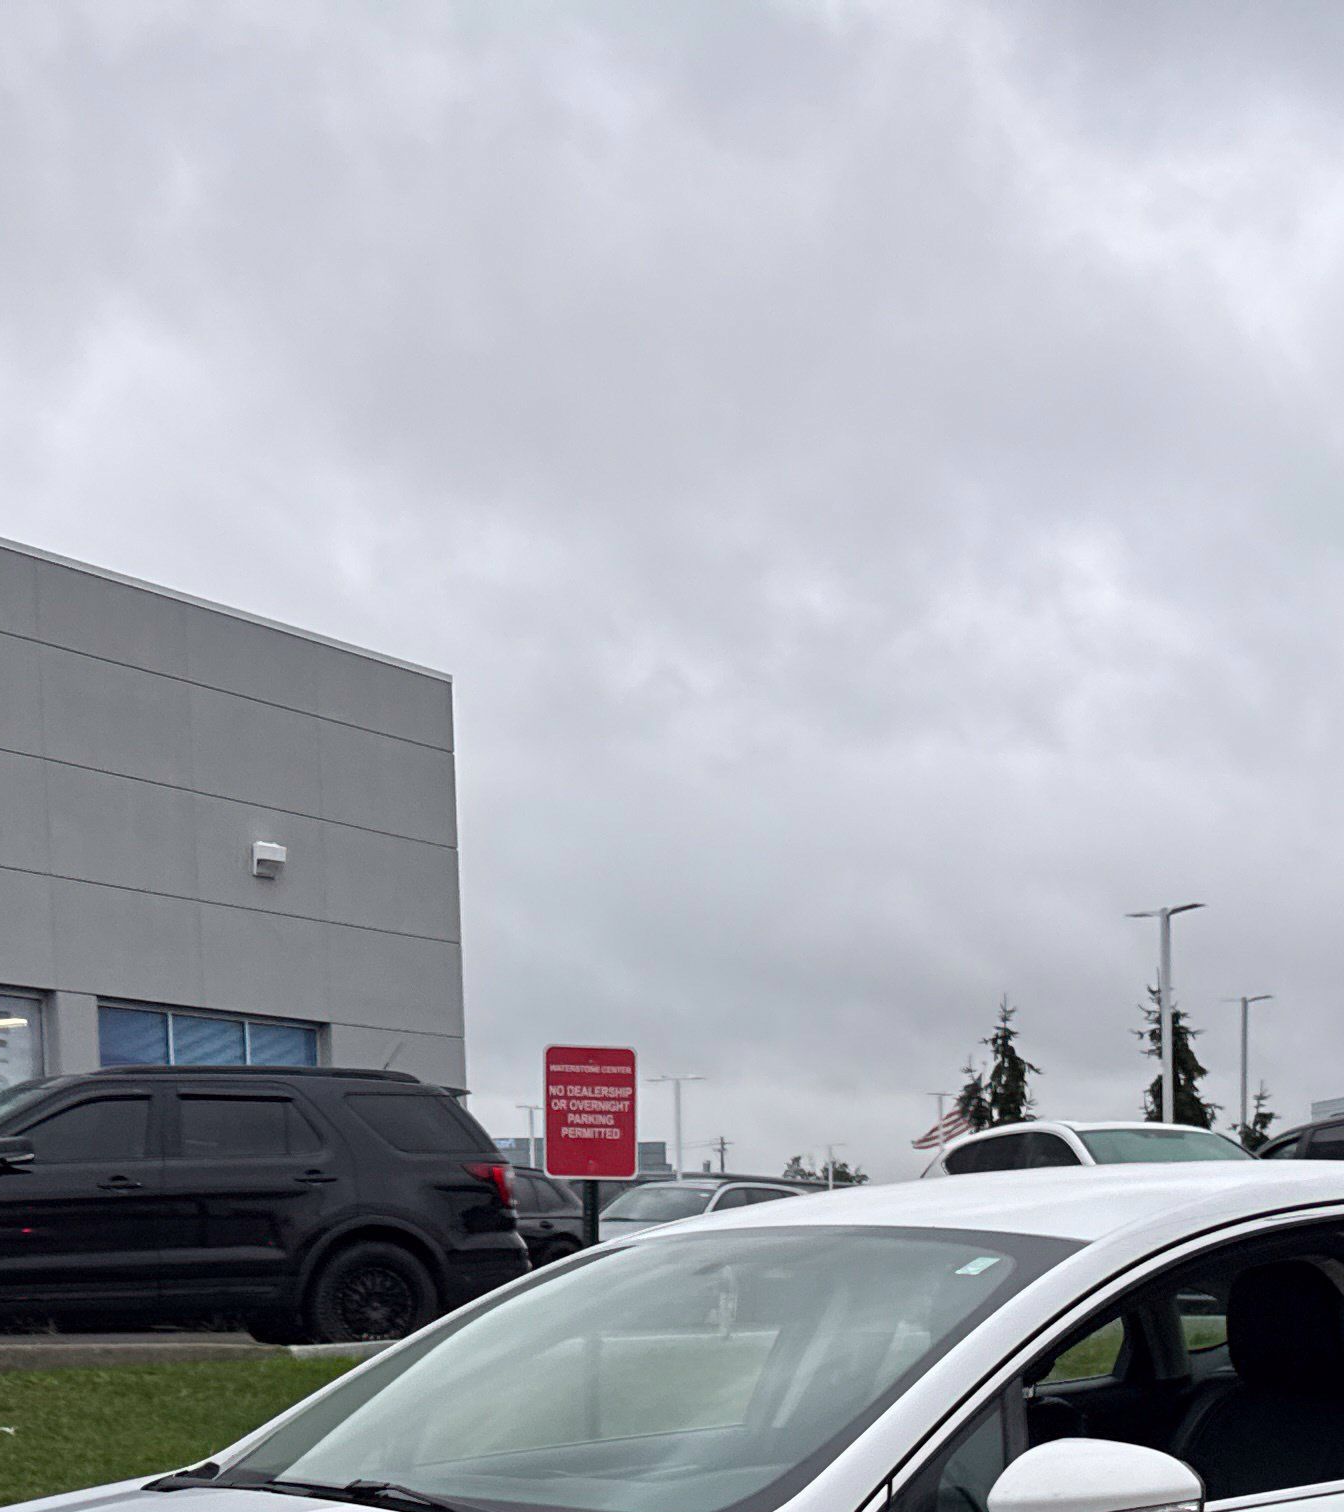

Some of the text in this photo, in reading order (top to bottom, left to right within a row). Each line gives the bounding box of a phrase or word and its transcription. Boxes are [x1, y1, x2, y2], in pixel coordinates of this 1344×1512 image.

[549, 1085, 632, 1098] NO DEALERSHIP
[551, 1099, 630, 1112] OR OVERNIGHT
[567, 1113, 614, 1125] PARKING
[561, 1126, 620, 1139] PERMITTED
